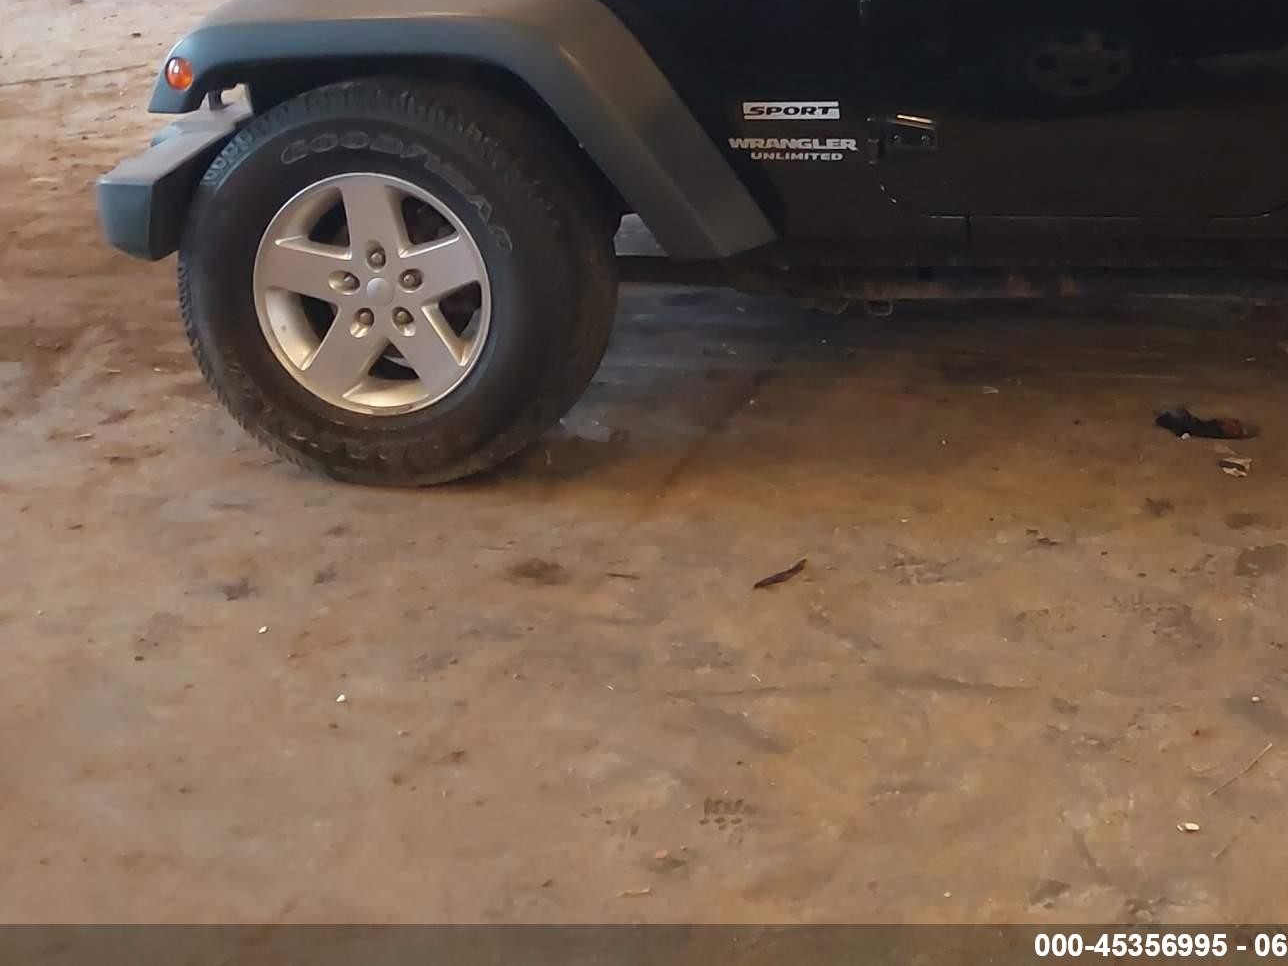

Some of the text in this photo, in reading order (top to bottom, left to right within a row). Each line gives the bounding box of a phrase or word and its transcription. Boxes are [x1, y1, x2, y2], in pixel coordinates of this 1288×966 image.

[743, 104, 840, 118] SPORT
[728, 137, 858, 151] WRANGLER
[750, 152, 843, 161] UNLIMITED
